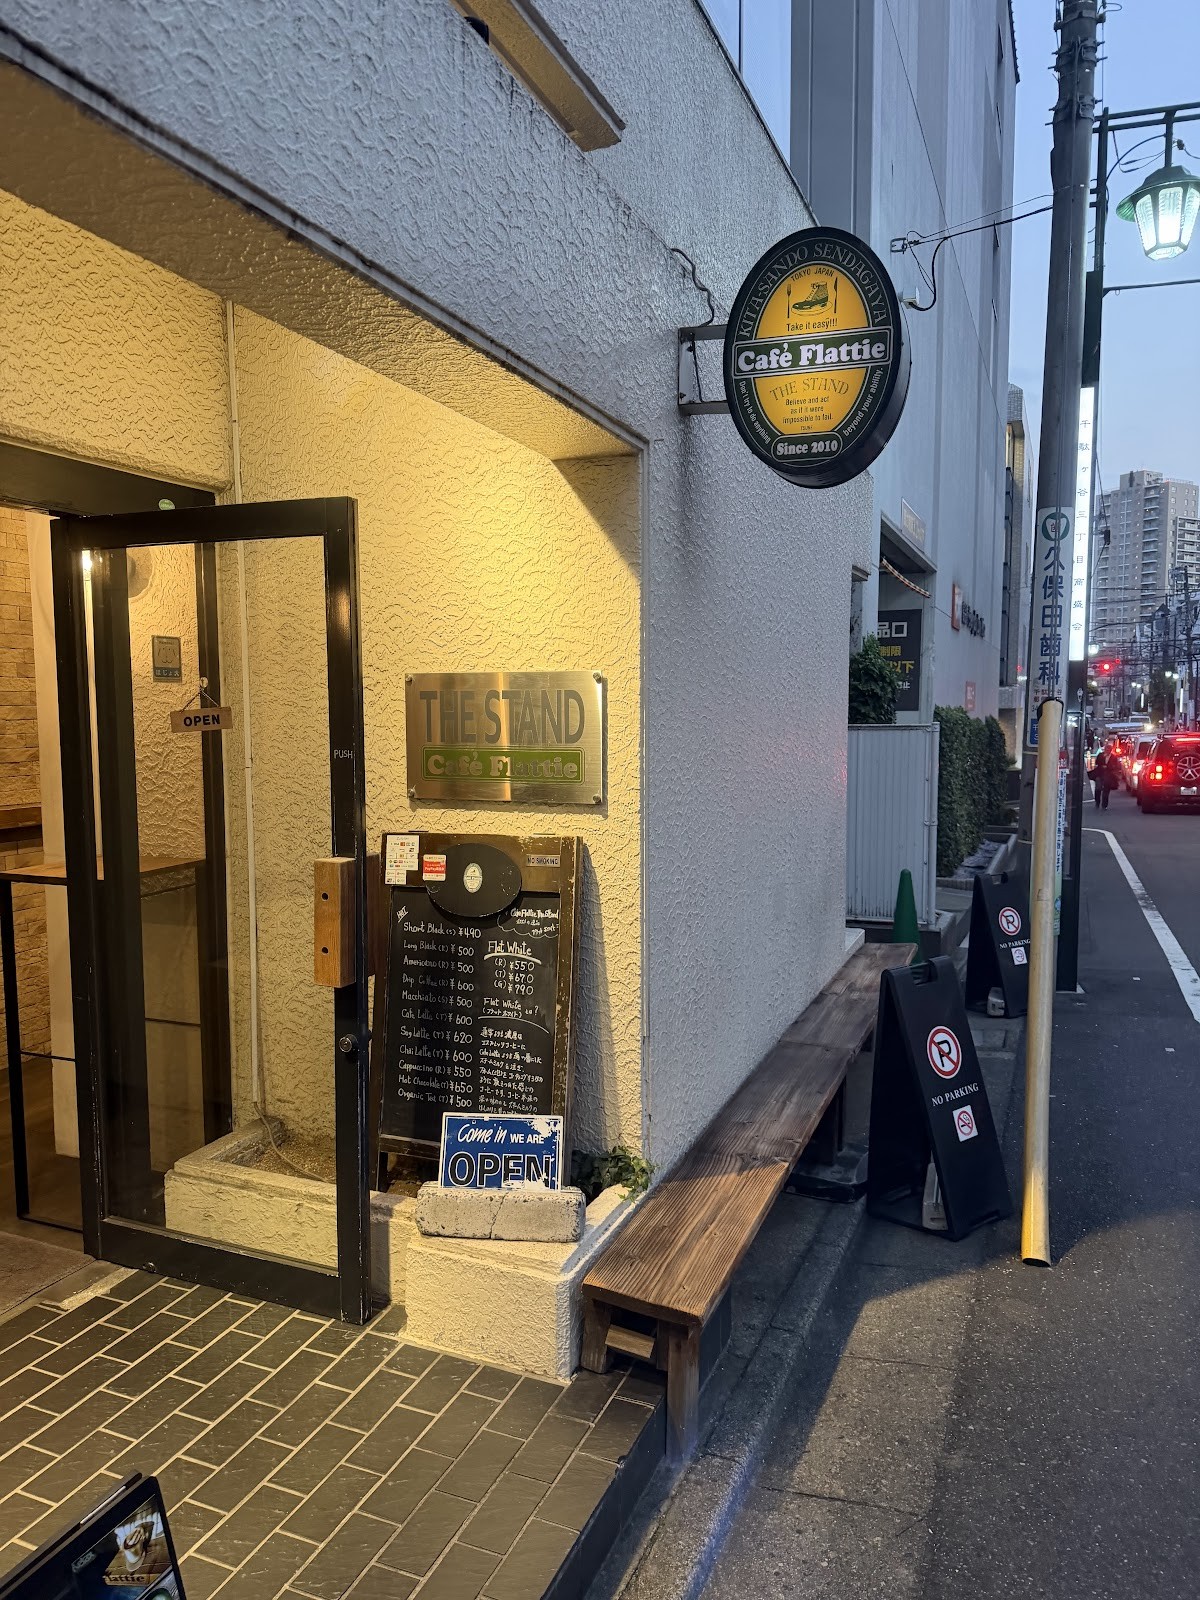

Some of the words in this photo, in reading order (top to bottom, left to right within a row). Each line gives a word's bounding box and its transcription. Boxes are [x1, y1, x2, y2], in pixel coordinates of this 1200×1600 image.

[790, 268, 811, 282] TOKYO
[814, 267, 834, 278] JAPAN
[738, 246, 808, 337] KITA-SANDO
[813, 243, 887, 324] SENDAGAYA
[786, 322, 804, 332] Take
[805, 321, 811, 330] it
[738, 342, 793, 372] Café
[799, 338, 886, 366] Flattie
[770, 381, 798, 400] THE
[802, 377, 849, 395] STAND
[785, 398, 807, 406] Believe
[843, 411, 864, 436] beyond
[862, 394, 873, 412] your
[870, 367, 883, 393] ability.
[782, 415, 814, 424] impossible
[750, 413, 756, 421] do
[754, 421, 771, 444] anything
[776, 442, 808, 456] Since
[810, 440, 838, 453] 2010
[1038, 547, 1066, 685] 久保田歯科
[183, 714, 221, 727] OPEN
[420, 690, 477, 743] THE
[484, 689, 585, 745] STAND
[333, 749, 353, 759] PUSH
[427, 751, 483, 776] Café
[490, 756, 578, 778] Flattie
[403, 921, 425, 933] Short
[427, 922, 445, 934] Black
[458, 927, 481, 938] ¥490
[403, 940, 418, 951] Long
[488, 940, 504, 954] Flat
[507, 941, 532, 956] White
[1008, 939, 1031, 948] PARKING
[403, 955, 437, 968] Americano
[494, 958, 507, 968] (R)
[402, 973, 414, 987] Drip
[494, 969, 506, 978] (T)
[402, 990, 437, 1002] Macchiato
[483, 997, 499, 1007] Flat
[502, 1000, 522, 1010] White
[401, 1008, 415, 1019] Cafe
[417, 1008, 433, 1020] Latte
[400, 1025, 412, 1038] Soy
[413, 1027, 431, 1040] Latte
[399, 1045, 414, 1056] Chai
[414, 1045, 431, 1058] Latte
[398, 1060, 433, 1073] Cappuccino
[398, 1074, 412, 1084] Hot
[412, 1077, 440, 1089] Chocolate
[449, 1080, 473, 1093] ¥650
[397, 1088, 424, 1101] Organic
[931, 1096, 944, 1107] NO
[945, 1082, 979, 1102] PARKING
[457, 1123, 493, 1143] Come
[494, 1126, 508, 1144] in
[510, 1133, 526, 1144] WE
[526, 1134, 545, 1144] ARE
[448, 1151, 552, 1189] OPEN
